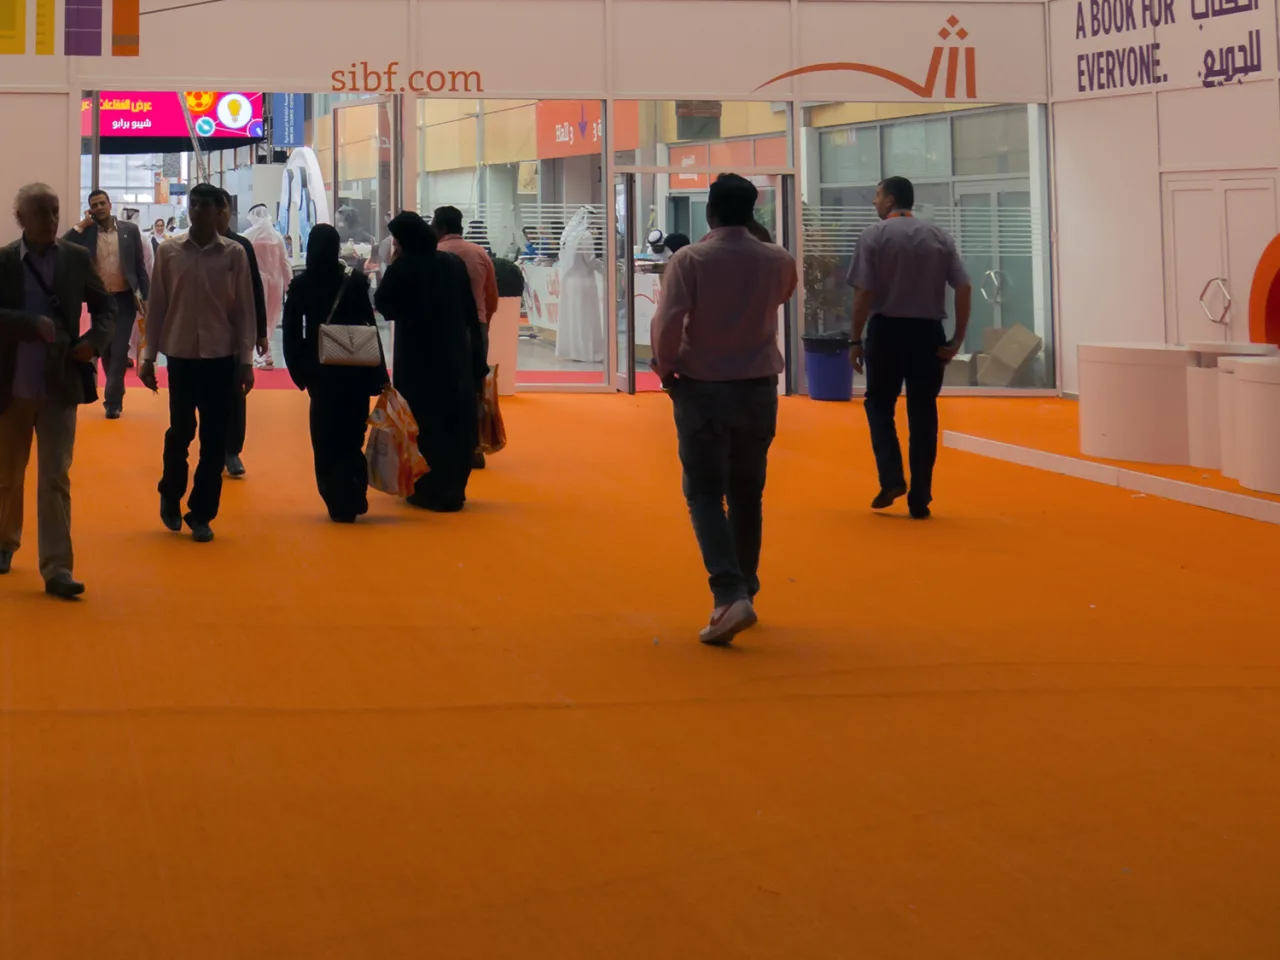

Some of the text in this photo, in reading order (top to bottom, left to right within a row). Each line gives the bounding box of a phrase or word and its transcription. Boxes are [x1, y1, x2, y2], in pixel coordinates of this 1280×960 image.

[1076, 1, 1087, 40] A
[331, 61, 483, 93] sibf.com
[1077, 43, 1168, 92] EVERYONE.
[131, 100, 152, 112] عرض
